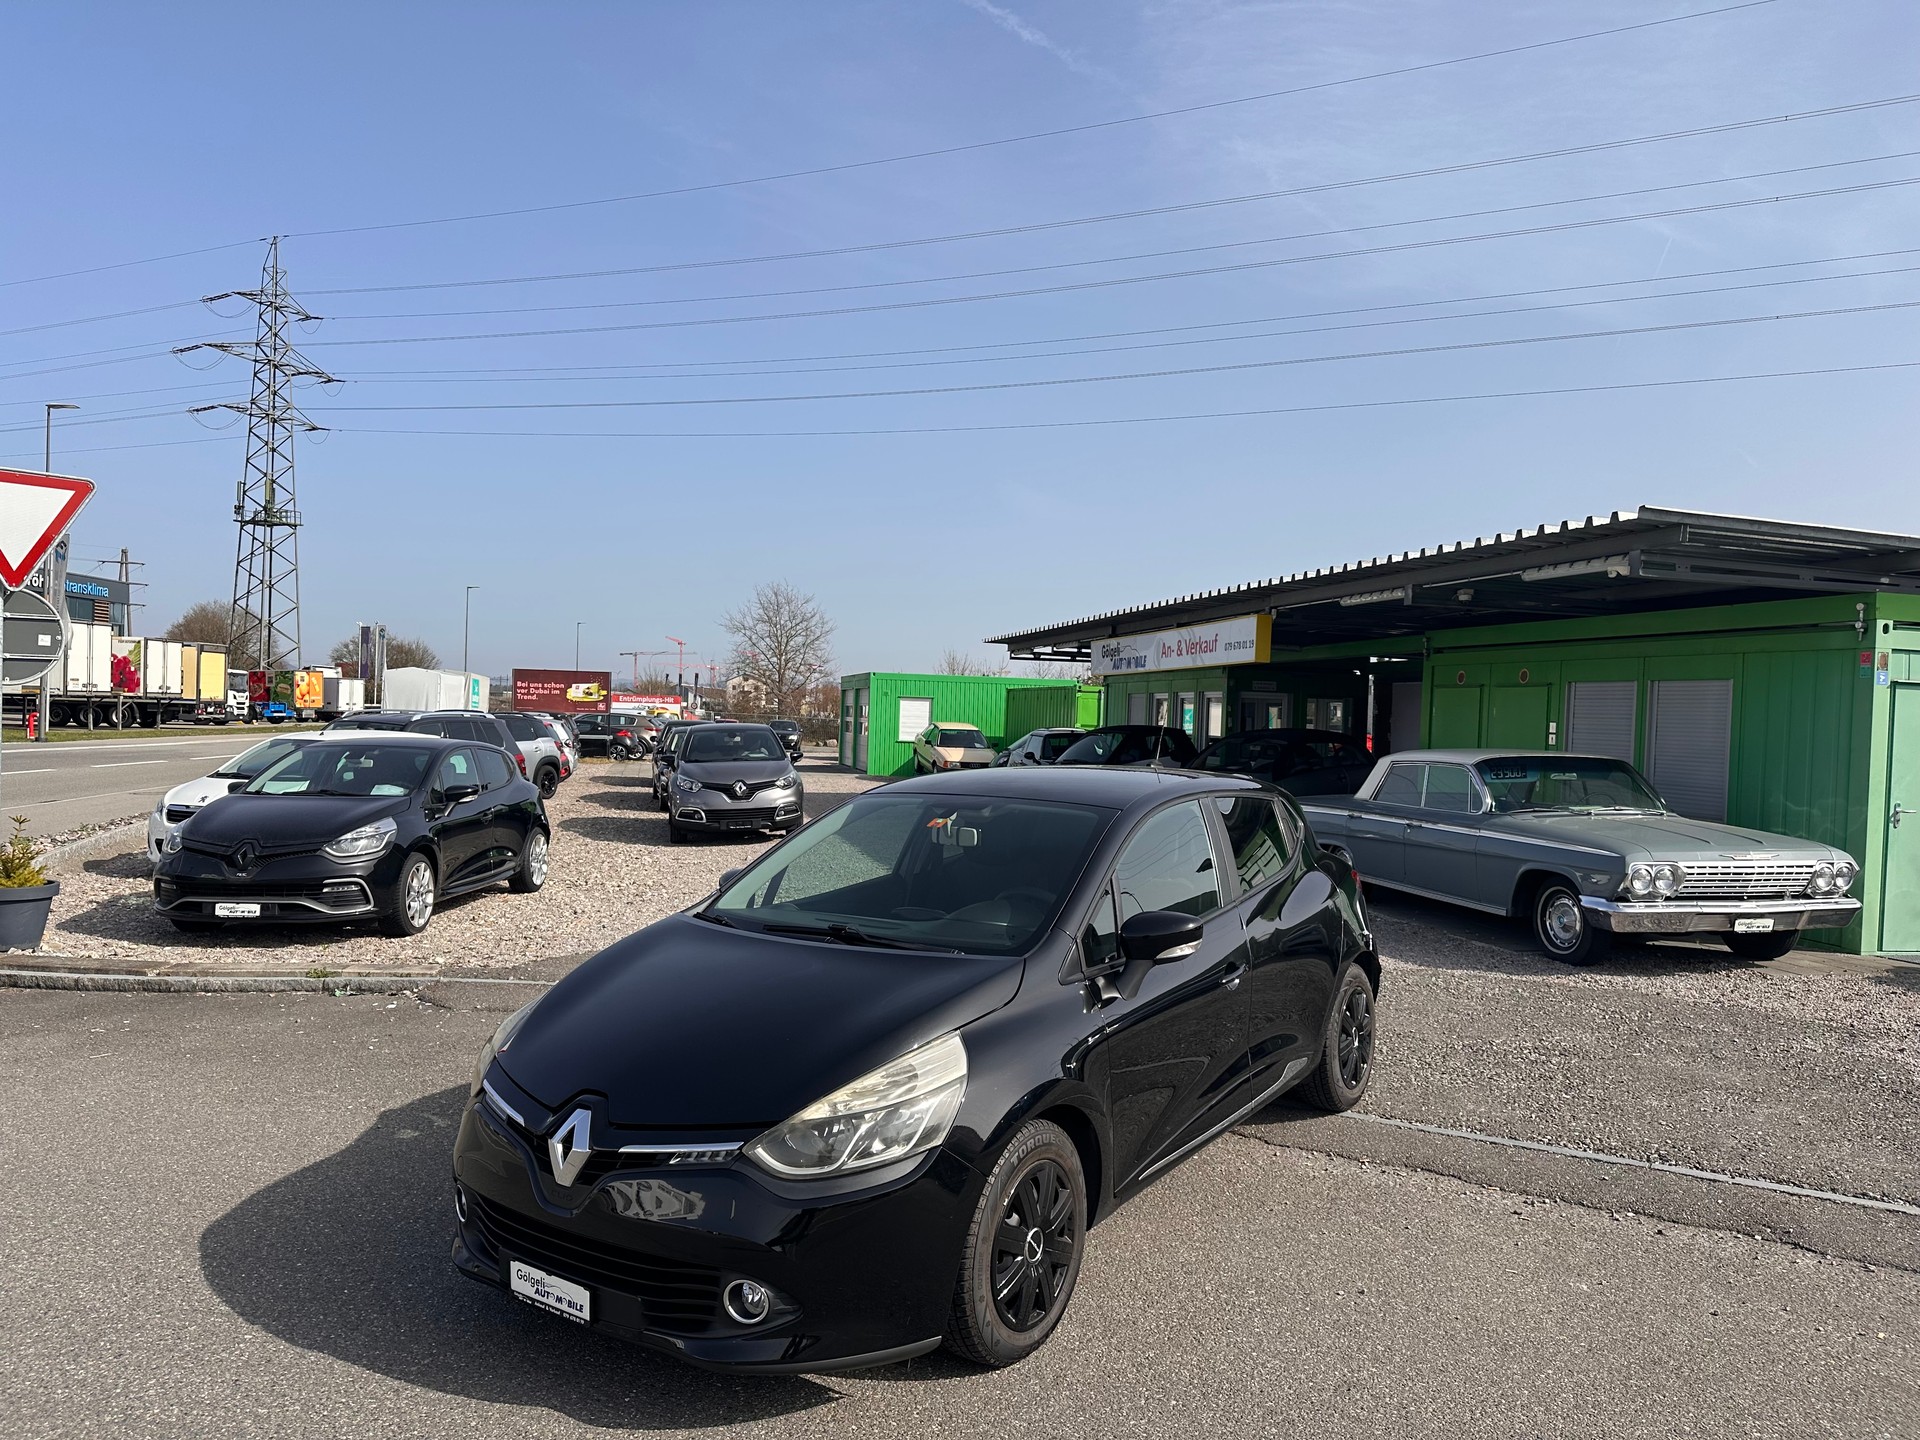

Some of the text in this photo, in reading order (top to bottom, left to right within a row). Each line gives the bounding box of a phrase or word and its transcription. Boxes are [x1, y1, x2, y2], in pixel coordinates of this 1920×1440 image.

[66, 580, 109, 597] transklima
[1101, 641, 1121, 662] Gölgeli
[1161, 633, 1219, 659] An- & Verkauf
[1010, 1133, 1057, 1167] TORQUE
[516, 1268, 545, 1288] Gölgeli
